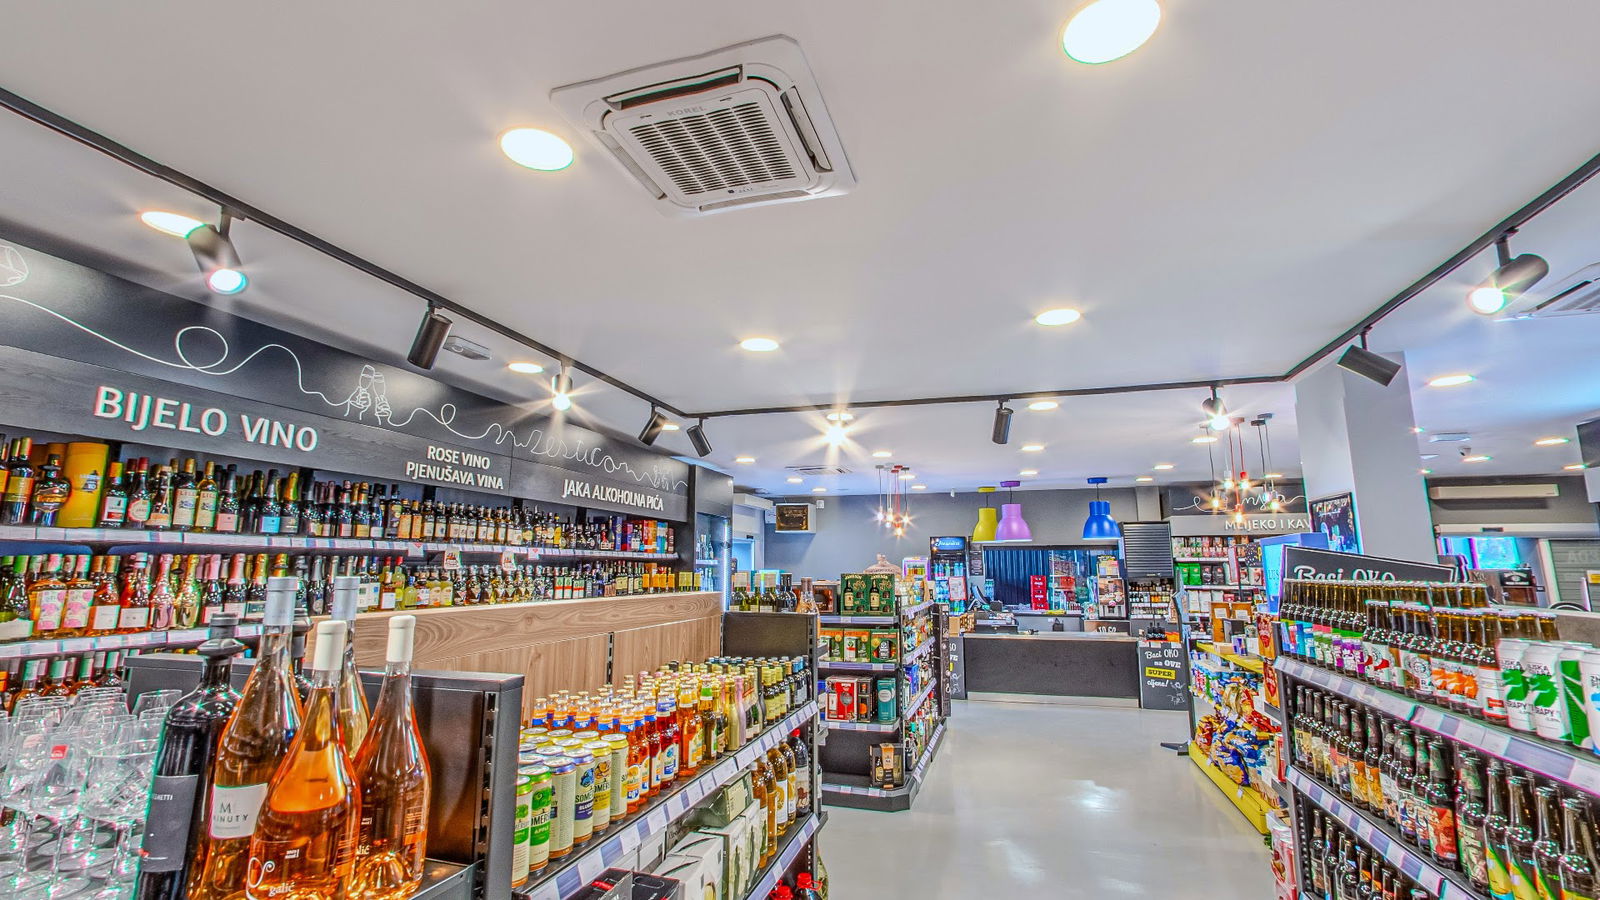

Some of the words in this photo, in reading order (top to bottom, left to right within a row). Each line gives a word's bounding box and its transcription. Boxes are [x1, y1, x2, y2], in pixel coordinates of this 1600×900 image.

[94, 386, 228, 436] BIJELO
[241, 414, 318, 451] VINO
[427, 445, 460, 464] ROSE
[461, 451, 491, 470] VINO
[405, 461, 475, 486] PJENUŠAVA
[476, 473, 504, 490] VINA
[562, 478, 591, 499] JAKA
[592, 484, 650, 507] ALKOHOLNA
[648, 494, 664, 511] PIĆA
[1144, 650, 1162, 659] Baci
[1163, 648, 1179, 658] OKO
[1164, 660, 1181, 668] OVE
[1148, 669, 1173, 677] SUPER
